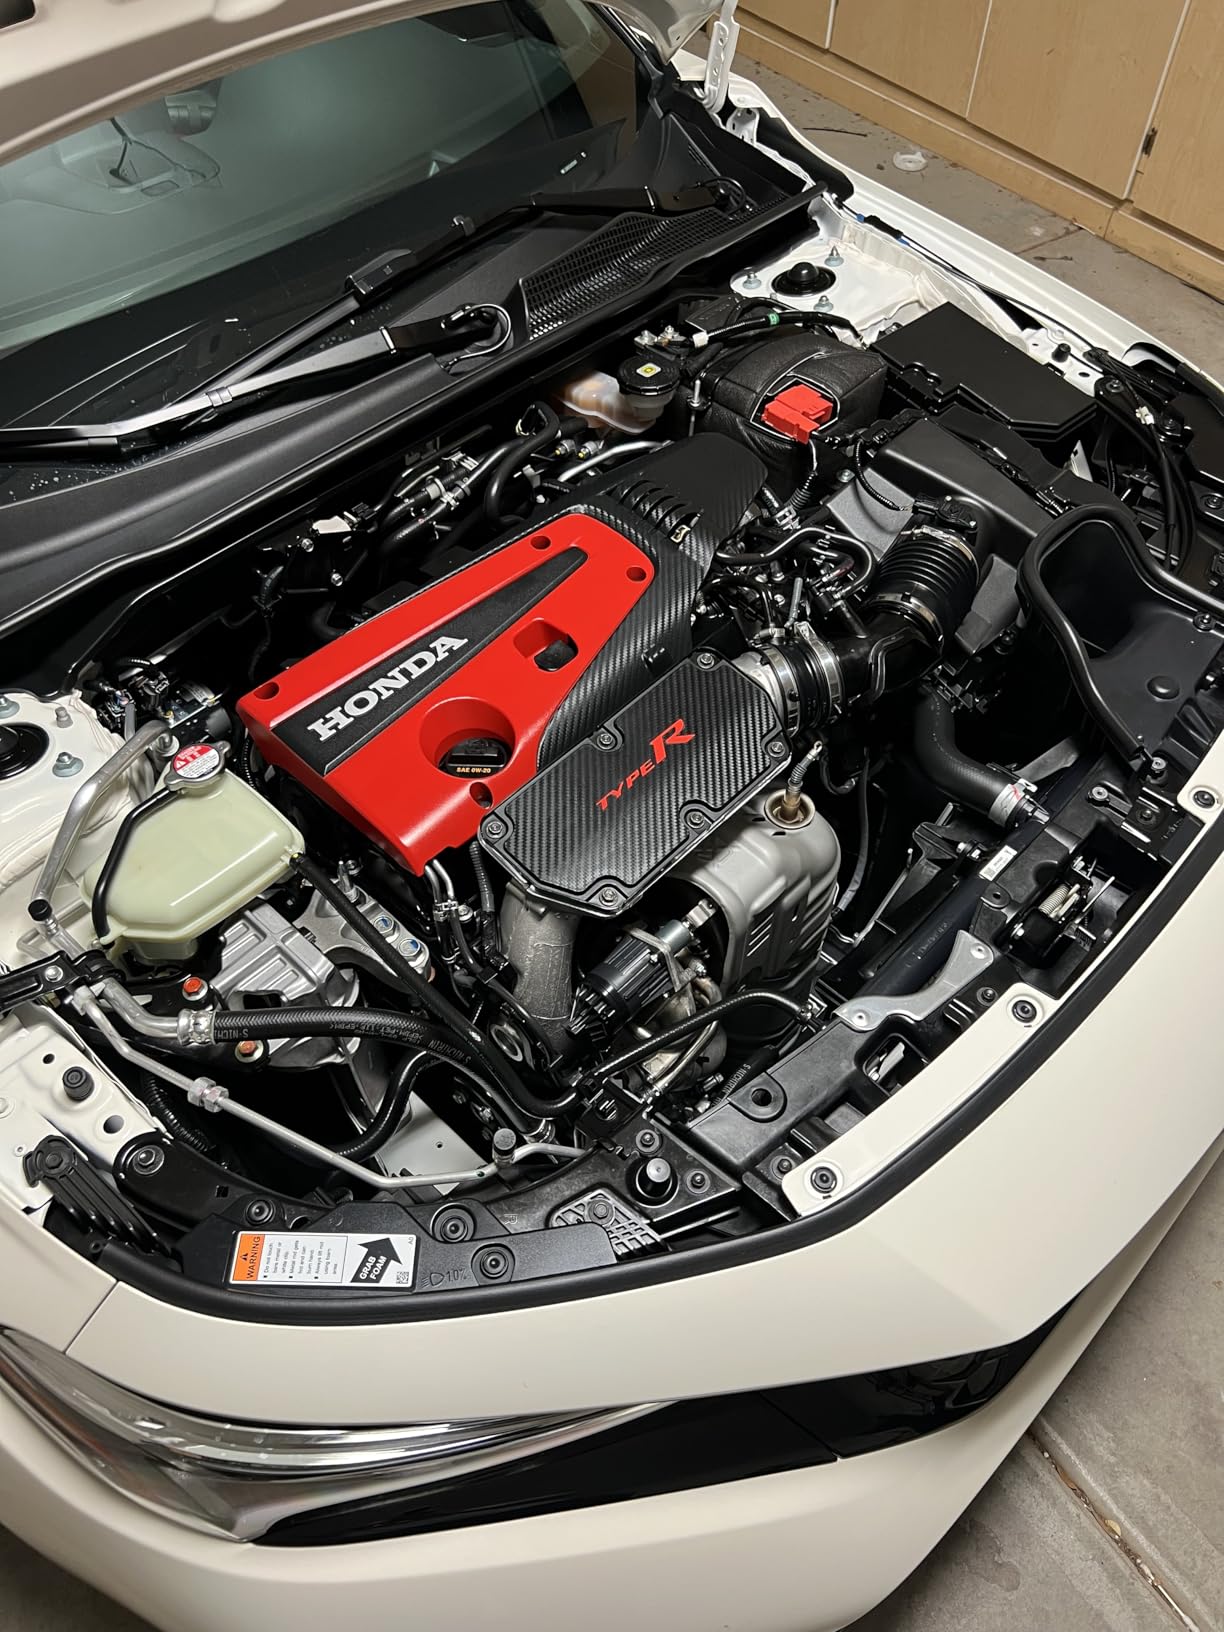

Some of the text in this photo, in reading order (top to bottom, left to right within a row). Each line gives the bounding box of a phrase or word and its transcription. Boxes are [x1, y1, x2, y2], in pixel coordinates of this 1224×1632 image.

[307, 636, 468, 741] HONDA
[596, 718, 696, 811] TYPE R
[246, 1236, 261, 1279] WARNING
[359, 1255, 377, 1280] GRAB
[369, 1255, 388, 1280] FOAM
